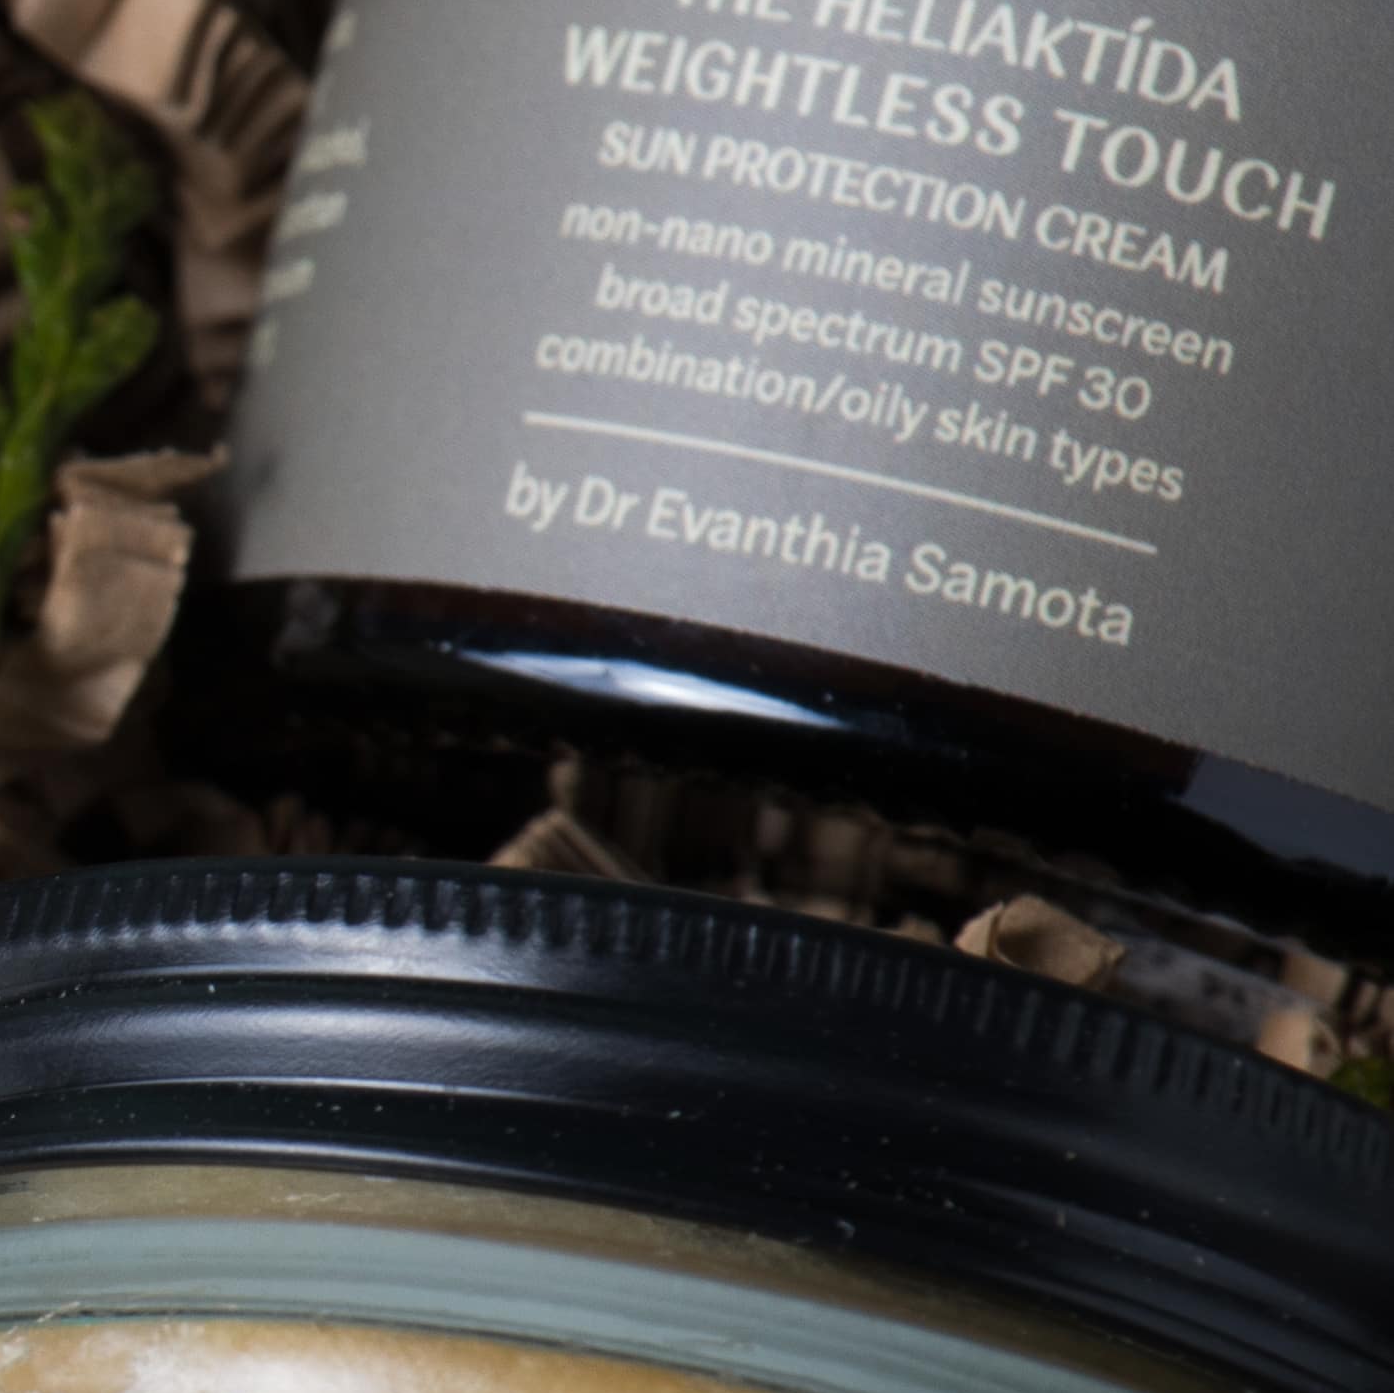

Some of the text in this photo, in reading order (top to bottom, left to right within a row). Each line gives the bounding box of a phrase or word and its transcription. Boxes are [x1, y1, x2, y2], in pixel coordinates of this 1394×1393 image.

[563, 24, 1336, 241] WEIGHTLESS TOUCH
[598, 121, 1230, 295] SUN PROTECTION CREAM
[560, 202, 1235, 375] non-nano mineral sunscreen
[597, 264, 1153, 422] broad spectrum SPF 30
[535, 328, 1186, 505] combination/oily skin types
[506, 463, 1137, 646] by Dr Evanthia Samota
